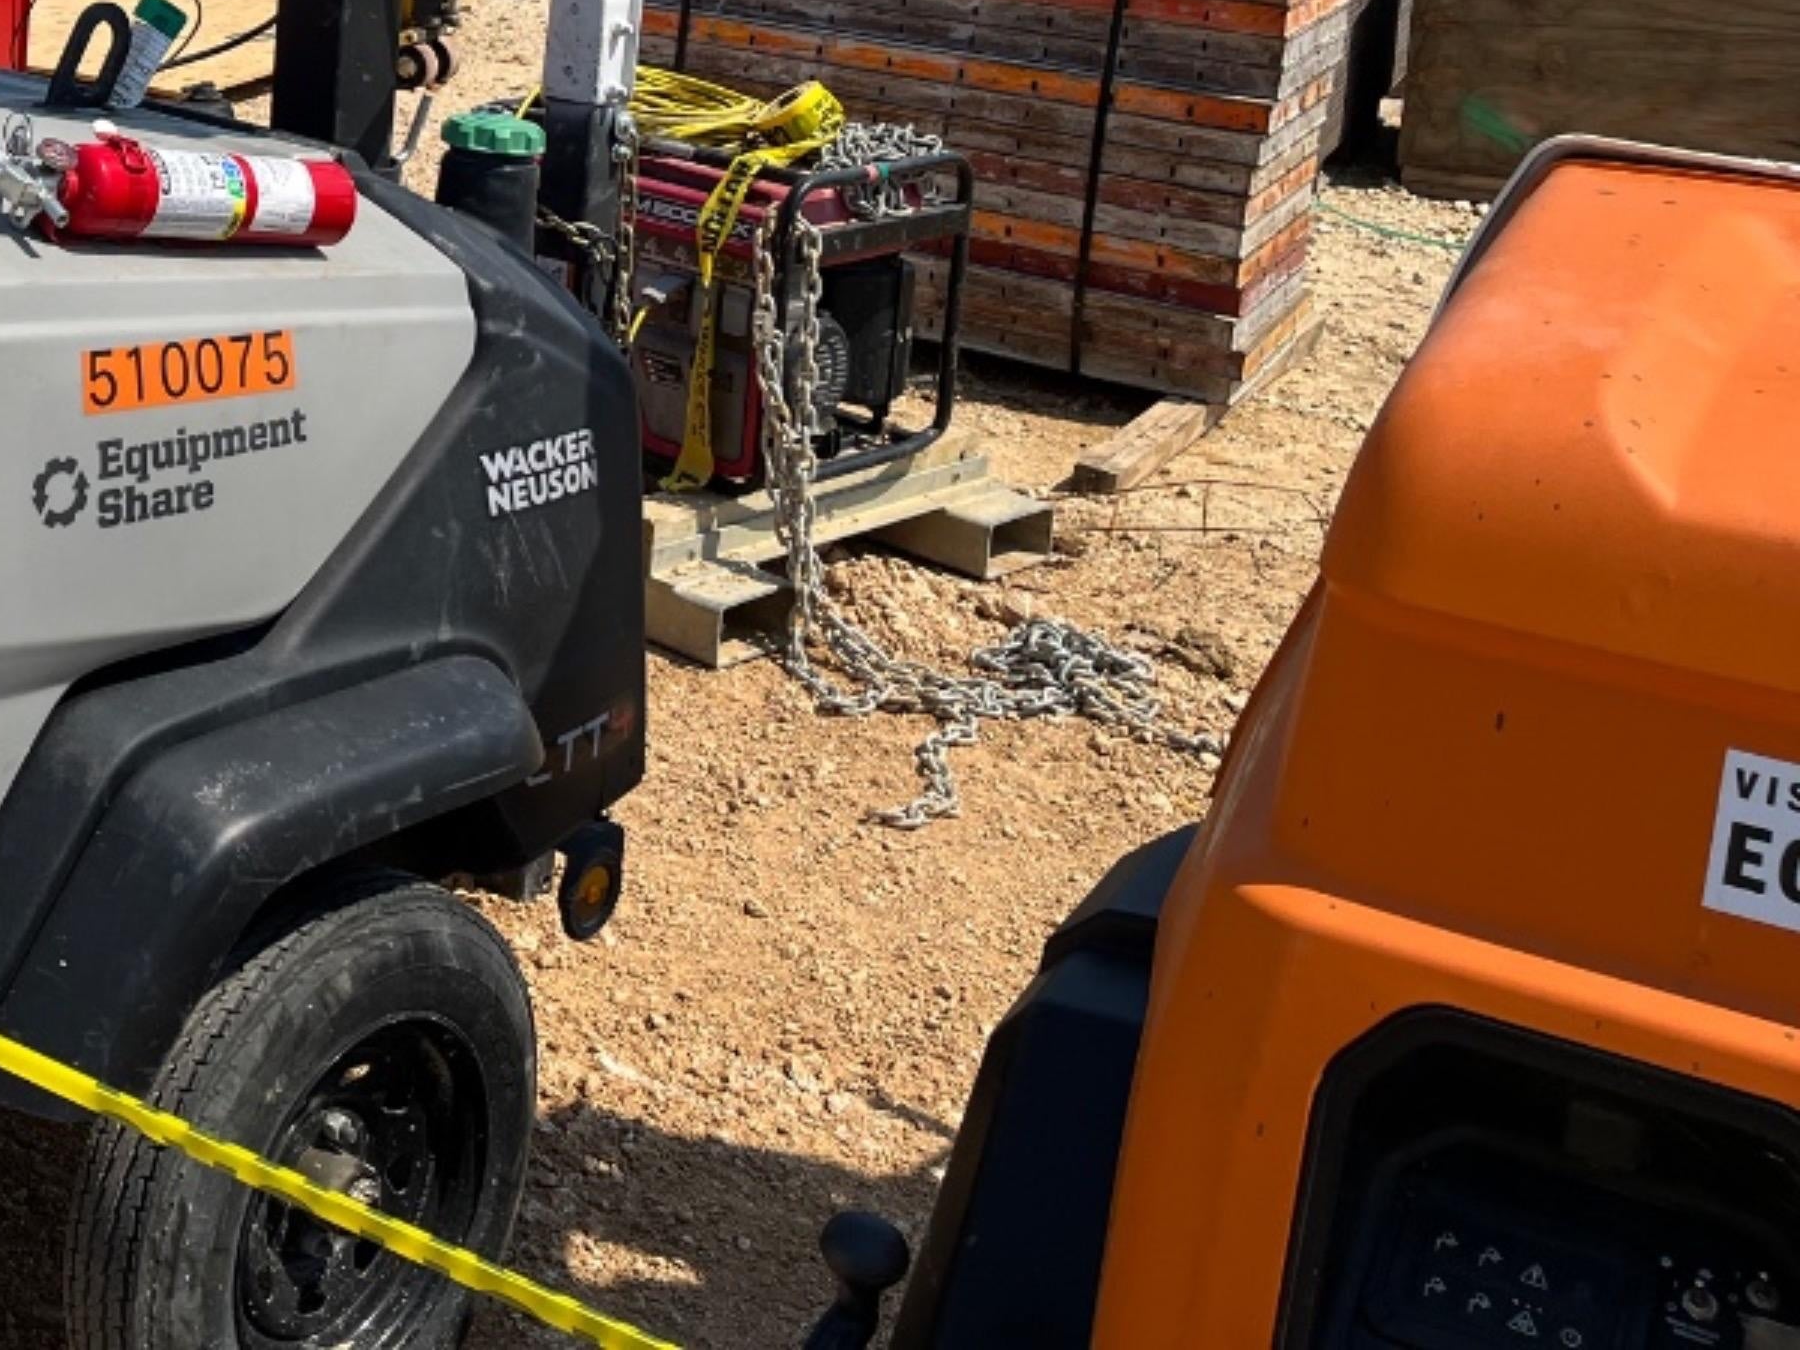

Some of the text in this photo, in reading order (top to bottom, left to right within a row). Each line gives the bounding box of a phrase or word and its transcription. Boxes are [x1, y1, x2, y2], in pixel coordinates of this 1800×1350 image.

[89, 330, 290, 407] 510075
[96, 407, 308, 483] Equipment
[479, 428, 597, 484] WACKER
[96, 478, 215, 529] Share
[486, 457, 599, 518] NEUSON
